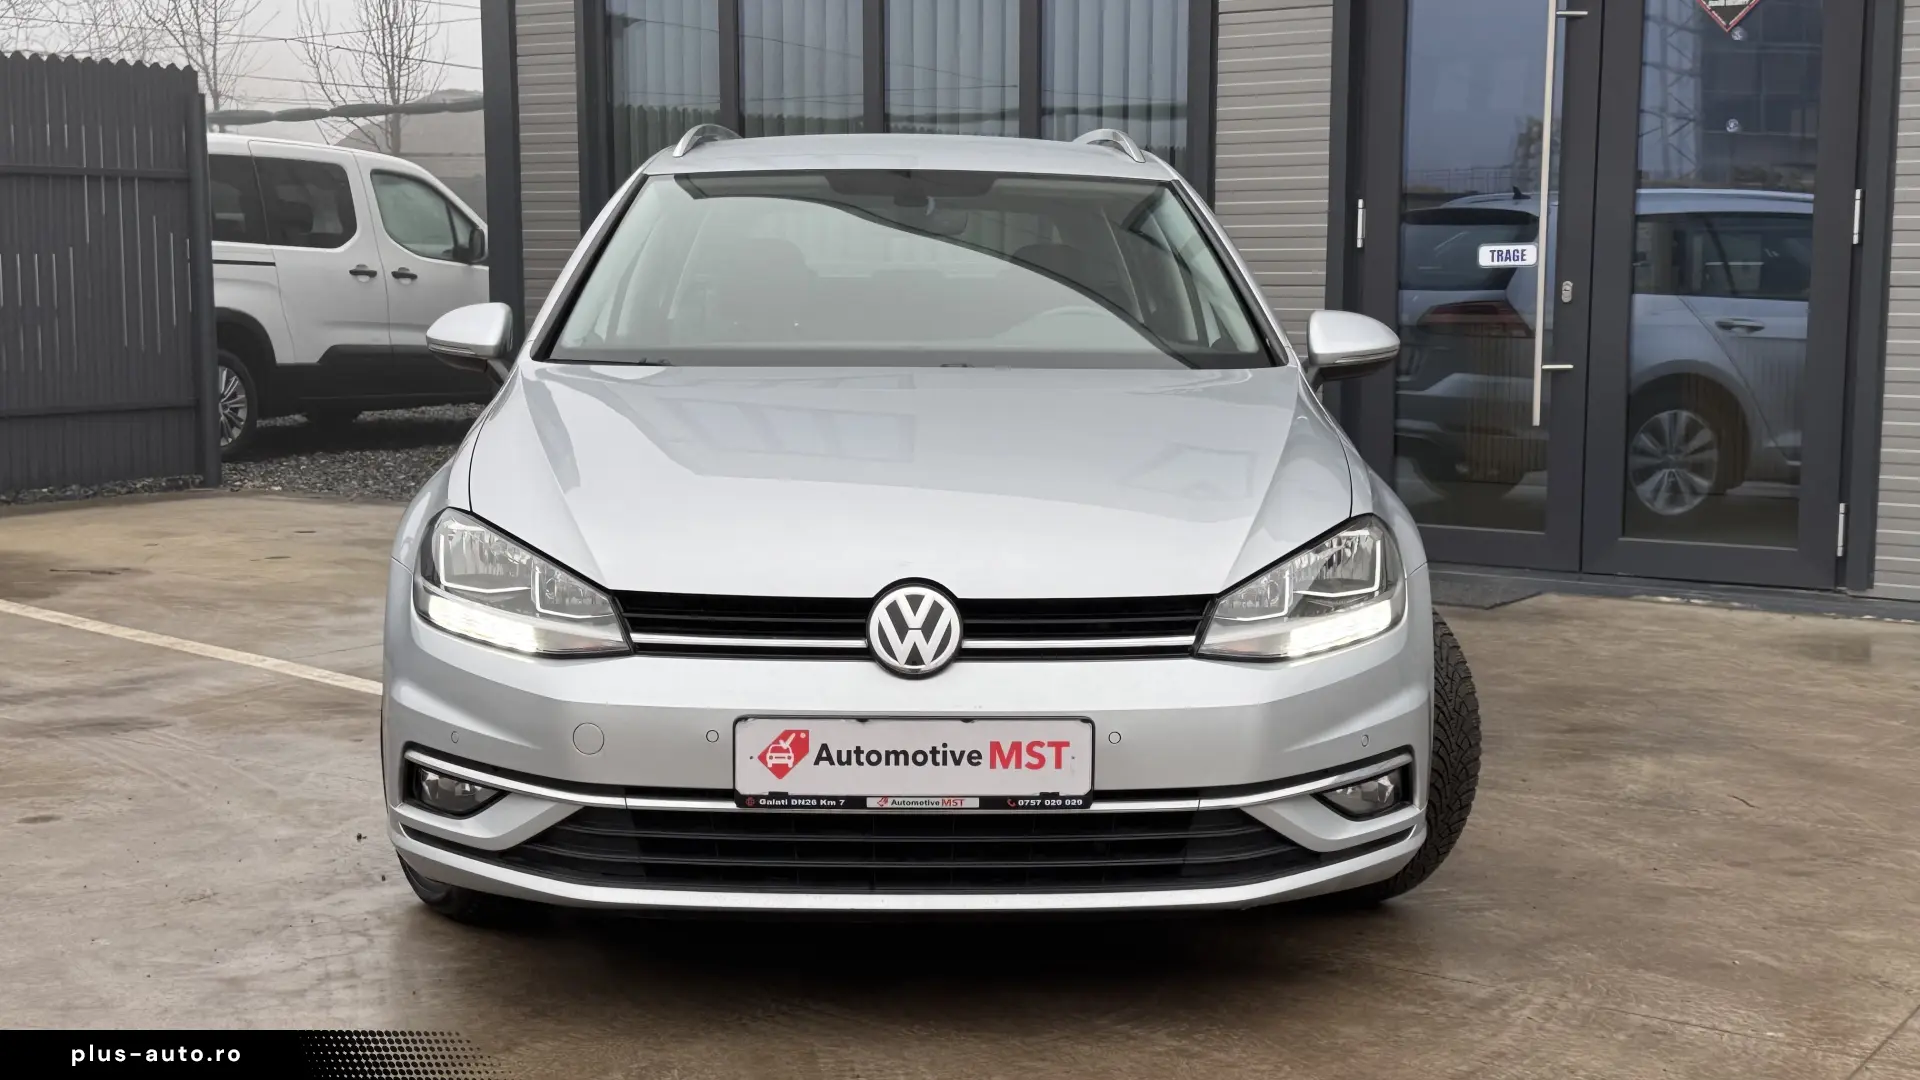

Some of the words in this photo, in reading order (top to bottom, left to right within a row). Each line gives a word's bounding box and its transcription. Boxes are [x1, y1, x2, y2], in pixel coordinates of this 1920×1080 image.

[1489, 248, 1527, 263] TRAGE
[813, 742, 983, 767] Automotive
[989, 740, 1070, 770] MST
[891, 799, 940, 807] Automotive
[941, 798, 965, 807] MST
